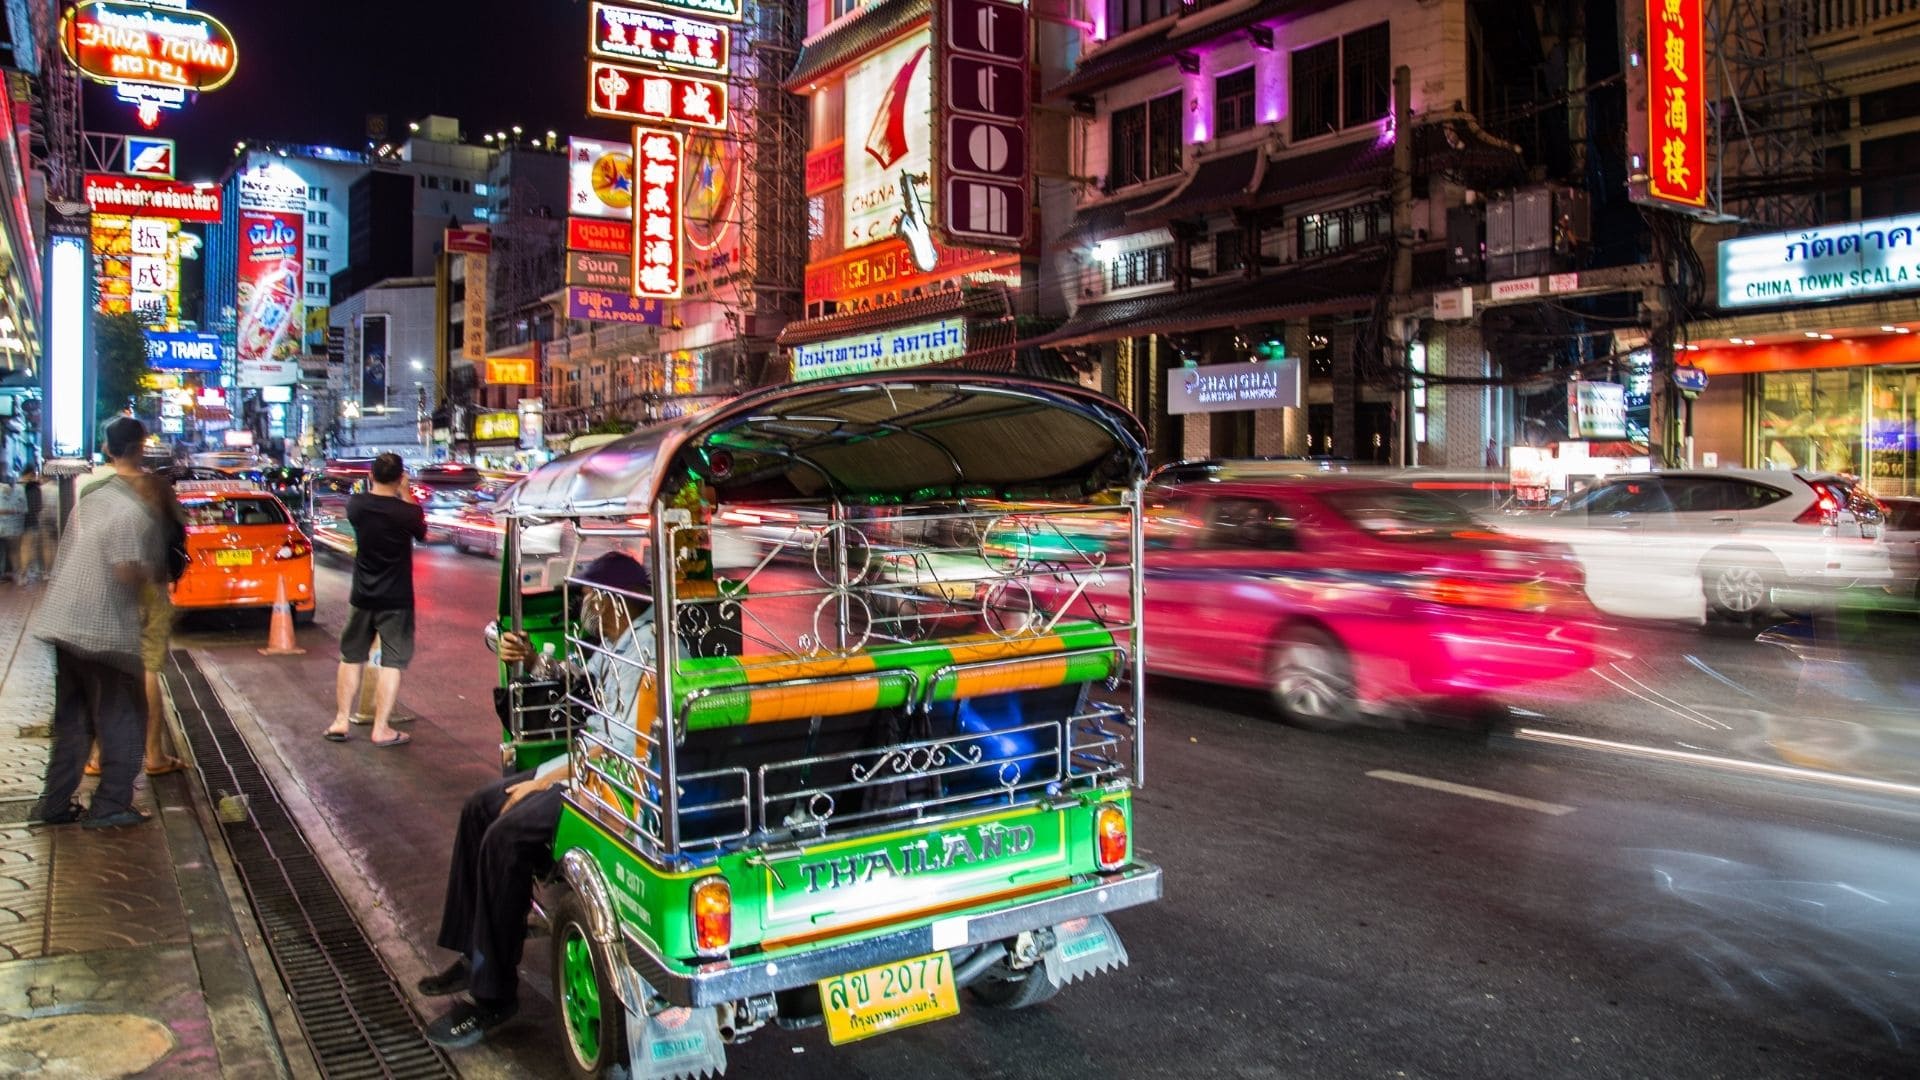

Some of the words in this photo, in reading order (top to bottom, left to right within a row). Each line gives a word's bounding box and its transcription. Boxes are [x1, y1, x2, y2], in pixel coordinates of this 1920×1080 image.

[77, 22, 150, 54] CHINA
[159, 35, 228, 67] TOWN
[598, 68, 716, 125] 中國城
[852, 184, 894, 212] CHINA
[588, 240, 625, 250] SHARK
[1785, 226, 1920, 262] ภัตตาค
[588, 273, 616, 284] BIRD
[1746, 279, 1792, 298] CHINA
[1799, 272, 1844, 292] TOWN
[1849, 265, 1908, 285] SCALA
[588, 309, 645, 322] SEAFOOD
[169, 341, 218, 360] TRAVEL
[1199, 371, 1278, 391] SHANGHAI
[1199, 391, 1237, 402] MANSION
[1240, 387, 1278, 399] BANGKOK
[799, 823, 1036, 894] THAILAND
[626, 868, 645, 900] 2077
[828, 974, 870, 1011] สข
[881, 956, 944, 998] 2077
